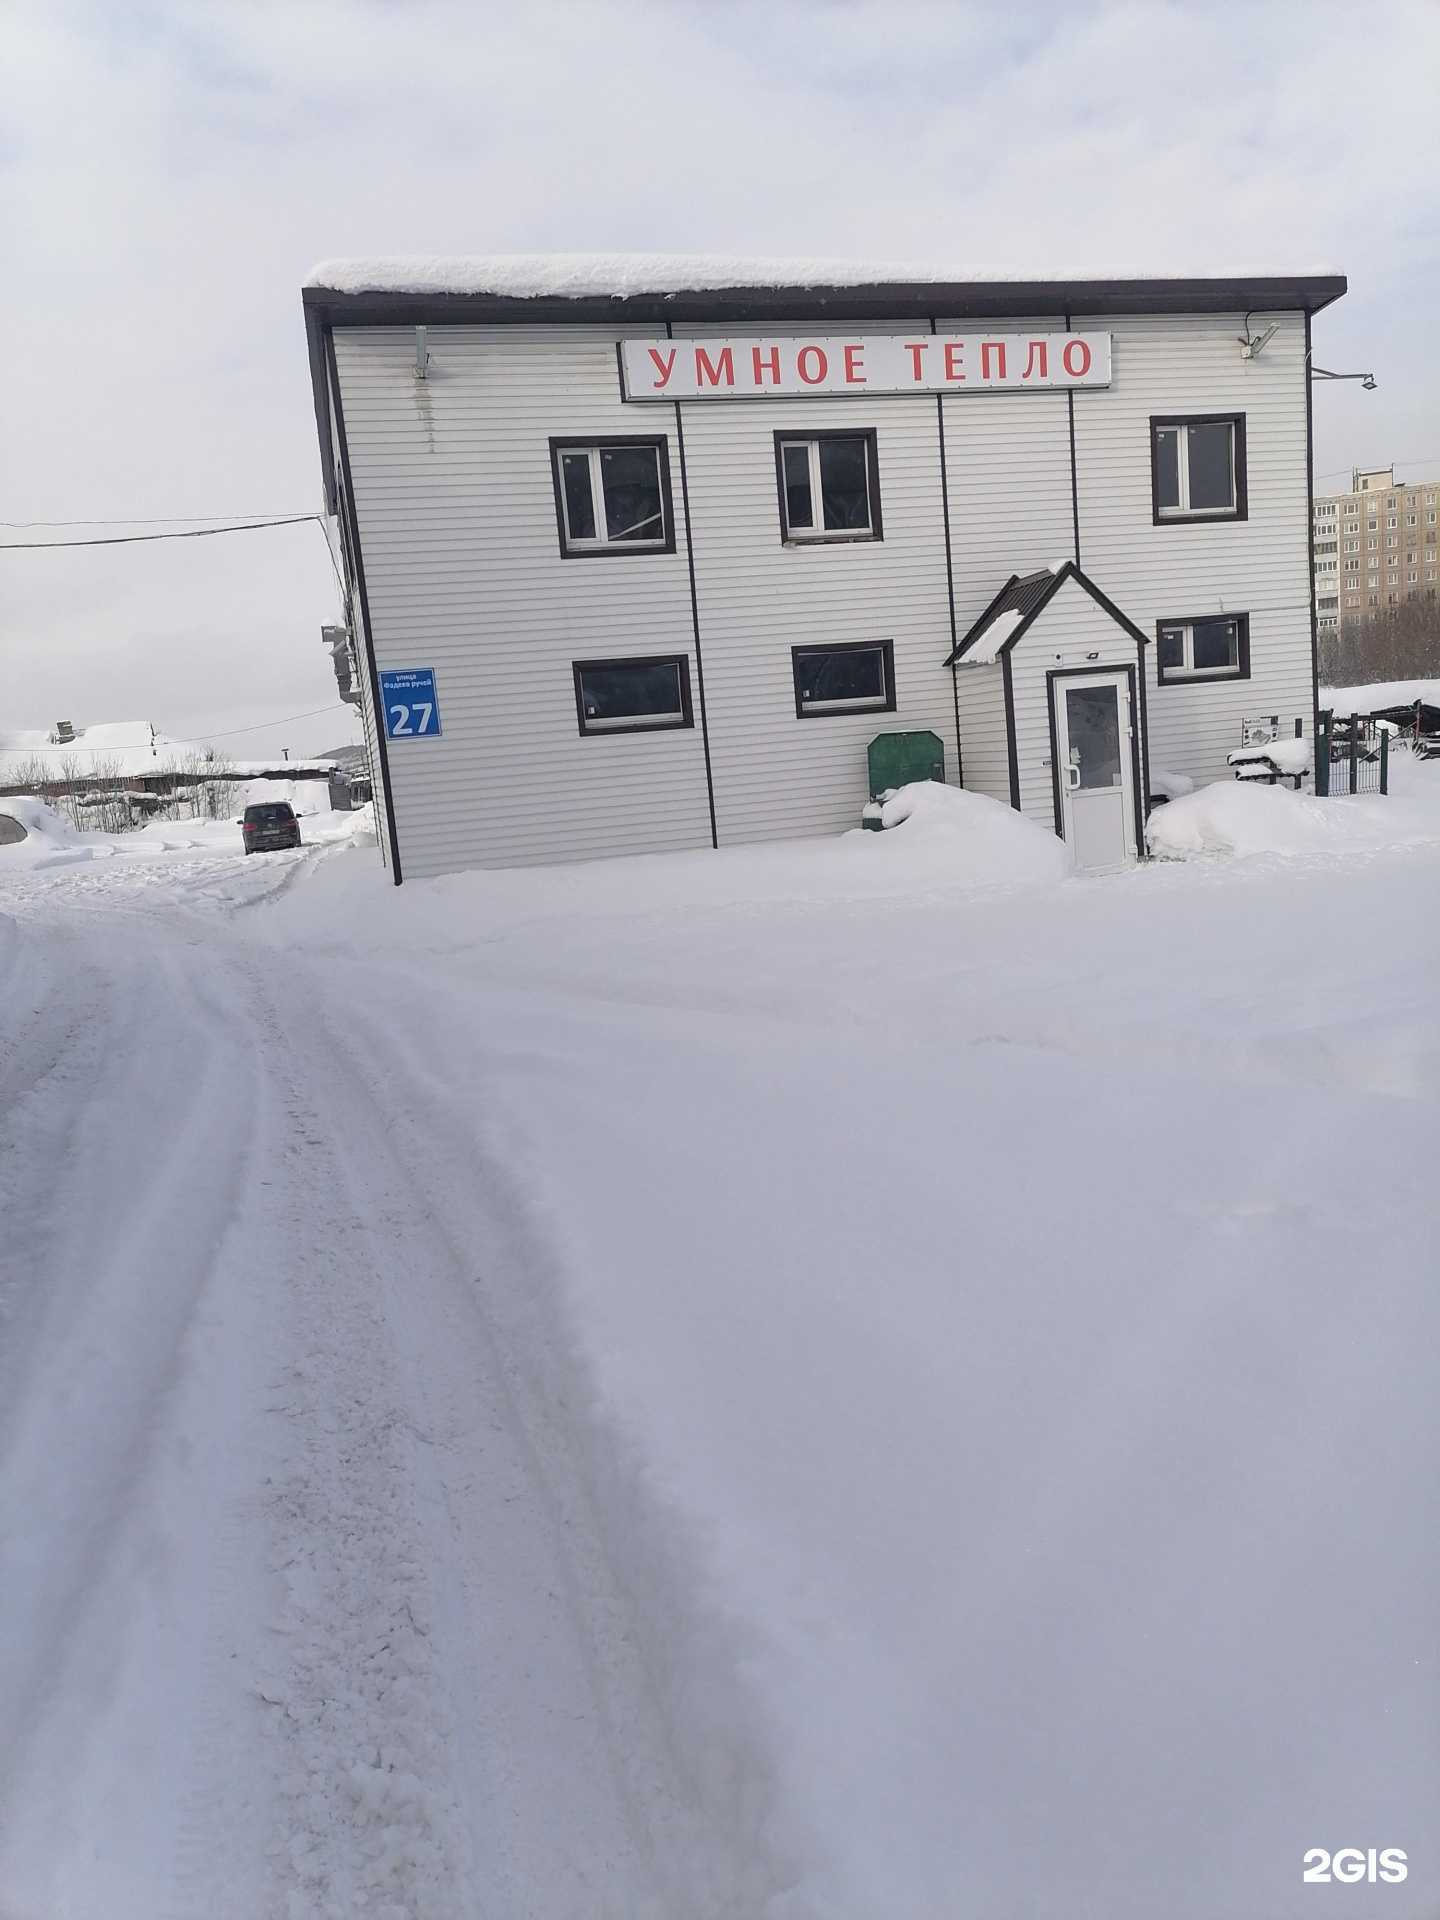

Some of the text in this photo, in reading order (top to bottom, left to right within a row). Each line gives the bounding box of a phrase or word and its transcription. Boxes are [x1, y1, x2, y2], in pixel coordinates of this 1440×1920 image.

[647, 339, 1092, 388] УМНОЕ ТЕПЛО
[396, 674, 417, 682] улица
[390, 703, 432, 735] 27
